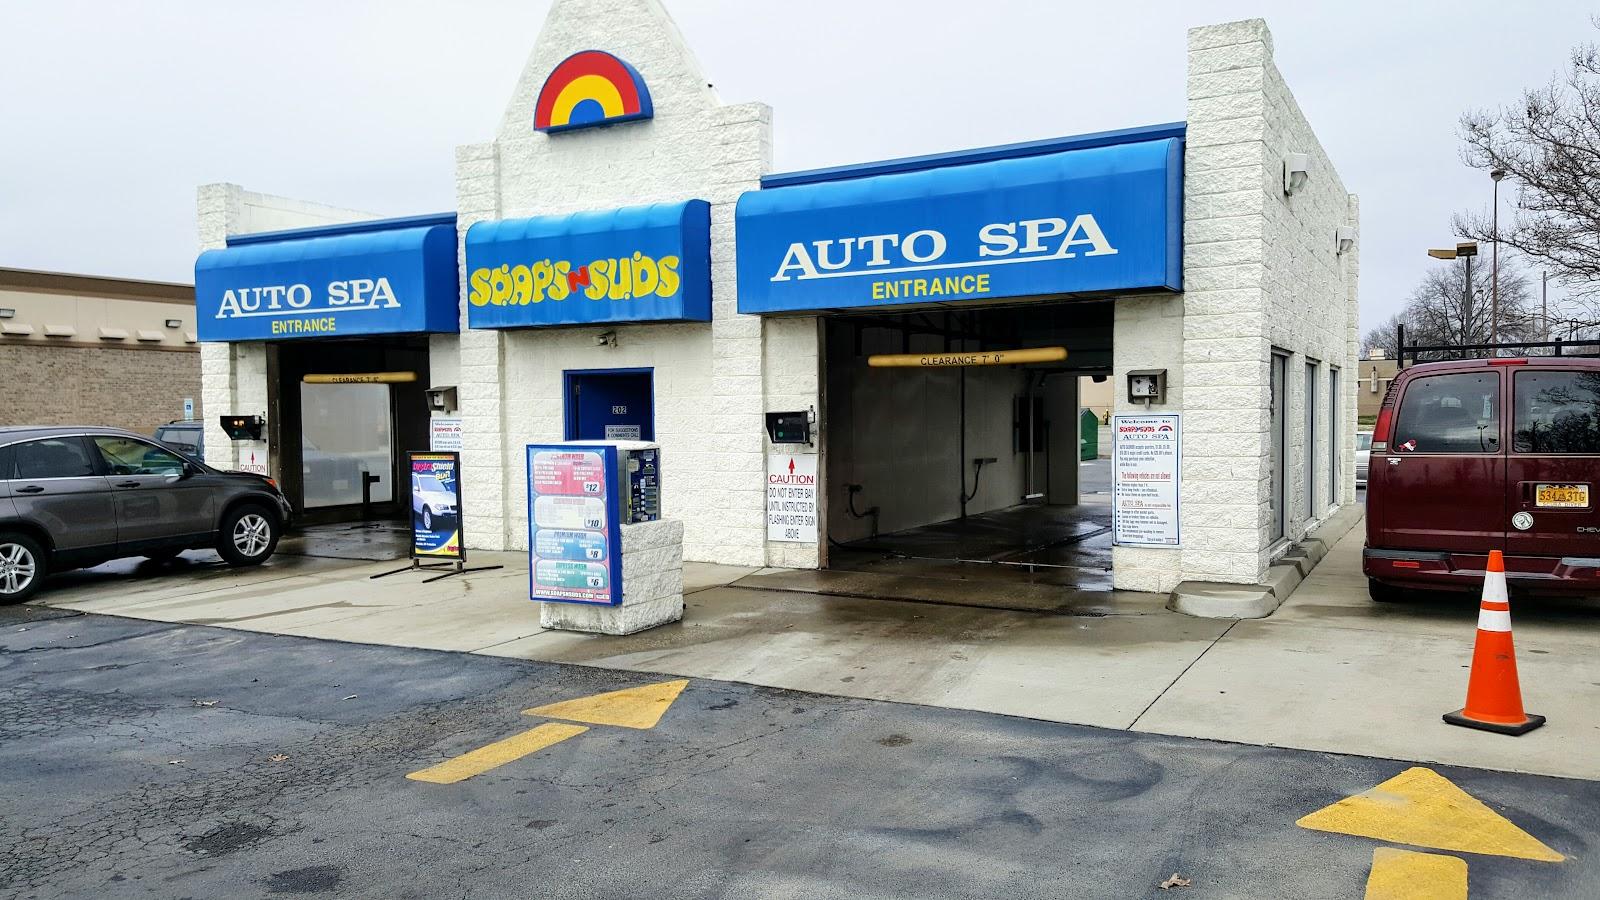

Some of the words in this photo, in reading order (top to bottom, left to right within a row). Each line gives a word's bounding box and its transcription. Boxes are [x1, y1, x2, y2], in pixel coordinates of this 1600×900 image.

[770, 230, 946, 282] AUTO
[978, 213, 1118, 258] SPA
[872, 273, 990, 300] ENTRANCE
[215, 284, 312, 319] AUTO
[327, 277, 401, 309] SPA
[272, 317, 336, 334] ENTRANCE
[920, 355, 976, 366] CLEARANCE
[613, 406, 626, 414] 202
[240, 464, 266, 472] CAUTION
[769, 474, 814, 484] CAUTION
[586, 484, 597, 492] $12
[769, 487, 776, 498] DO
[778, 487, 787, 498] NOT
[788, 487, 803, 499] ENTER
[805, 488, 814, 499] BAY
[769, 501, 781, 512] UNTIL
[782, 501, 808, 513] INSTRUCTED
[809, 502, 814, 512] BY
[769, 514, 789, 525] FLASHING
[790, 515, 803, 526] ENTER
[805, 515, 815, 526] SIGN
[785, 528, 799, 539] ABOVE
[590, 550, 599, 559] $8
